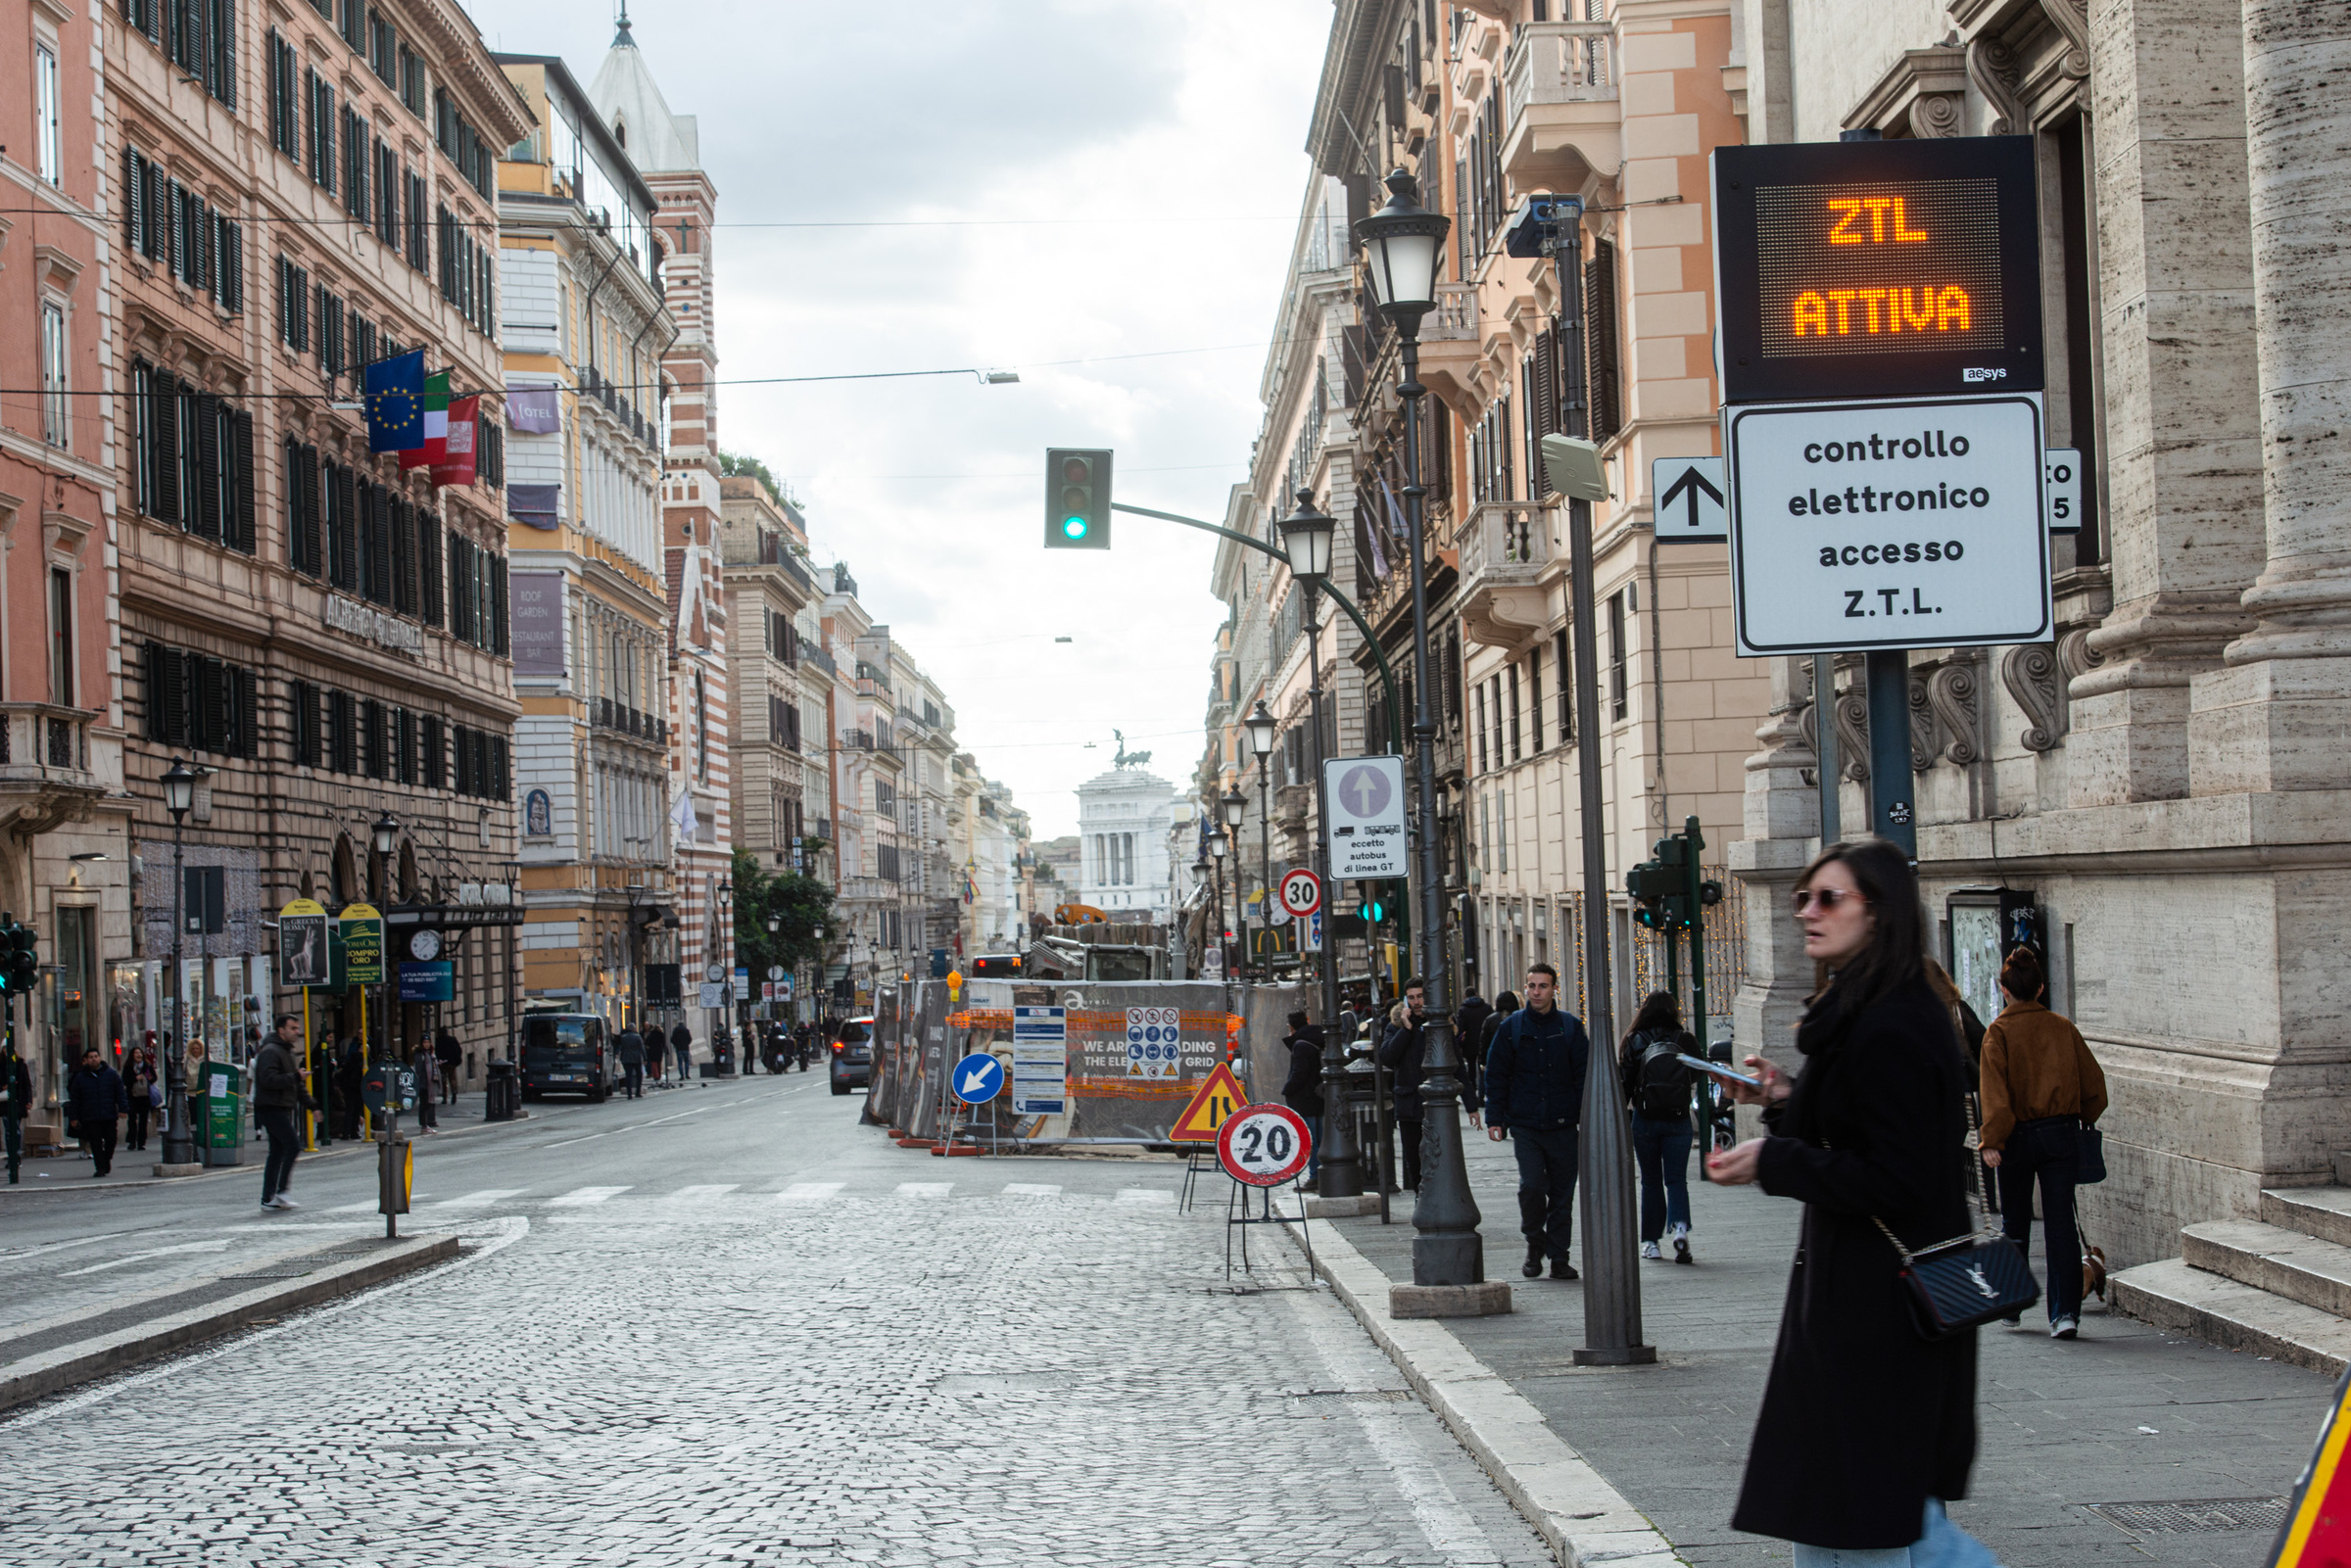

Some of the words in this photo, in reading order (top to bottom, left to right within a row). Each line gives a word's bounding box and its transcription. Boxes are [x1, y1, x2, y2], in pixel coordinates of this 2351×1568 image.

[1829, 198, 1927, 244] ZTL
[1794, 286, 1970, 337] ATTIVA
[1966, 367, 2007, 380] aesys
[1803, 430, 1970, 463] controllo
[2046, 464, 2072, 483] o
[1789, 482, 1990, 516] elettronico
[1819, 540, 1964, 567] accesso
[520, 591, 542, 601] ROOF
[1844, 588, 1943, 617] Z.T.L.
[517, 607, 549, 617] GARDEN
[1351, 839, 1385, 848] eccetto
[1289, 882, 1315, 904] 30
[1082, 1041, 1104, 1052] WE
[1106, 1041, 1128, 1052] AR
[1084, 1056, 1106, 1067] THE
[1108, 1056, 1128, 1067] ELE
[1185, 1057, 1215, 1067] GRID
[1240, 1125, 1291, 1163] 20
